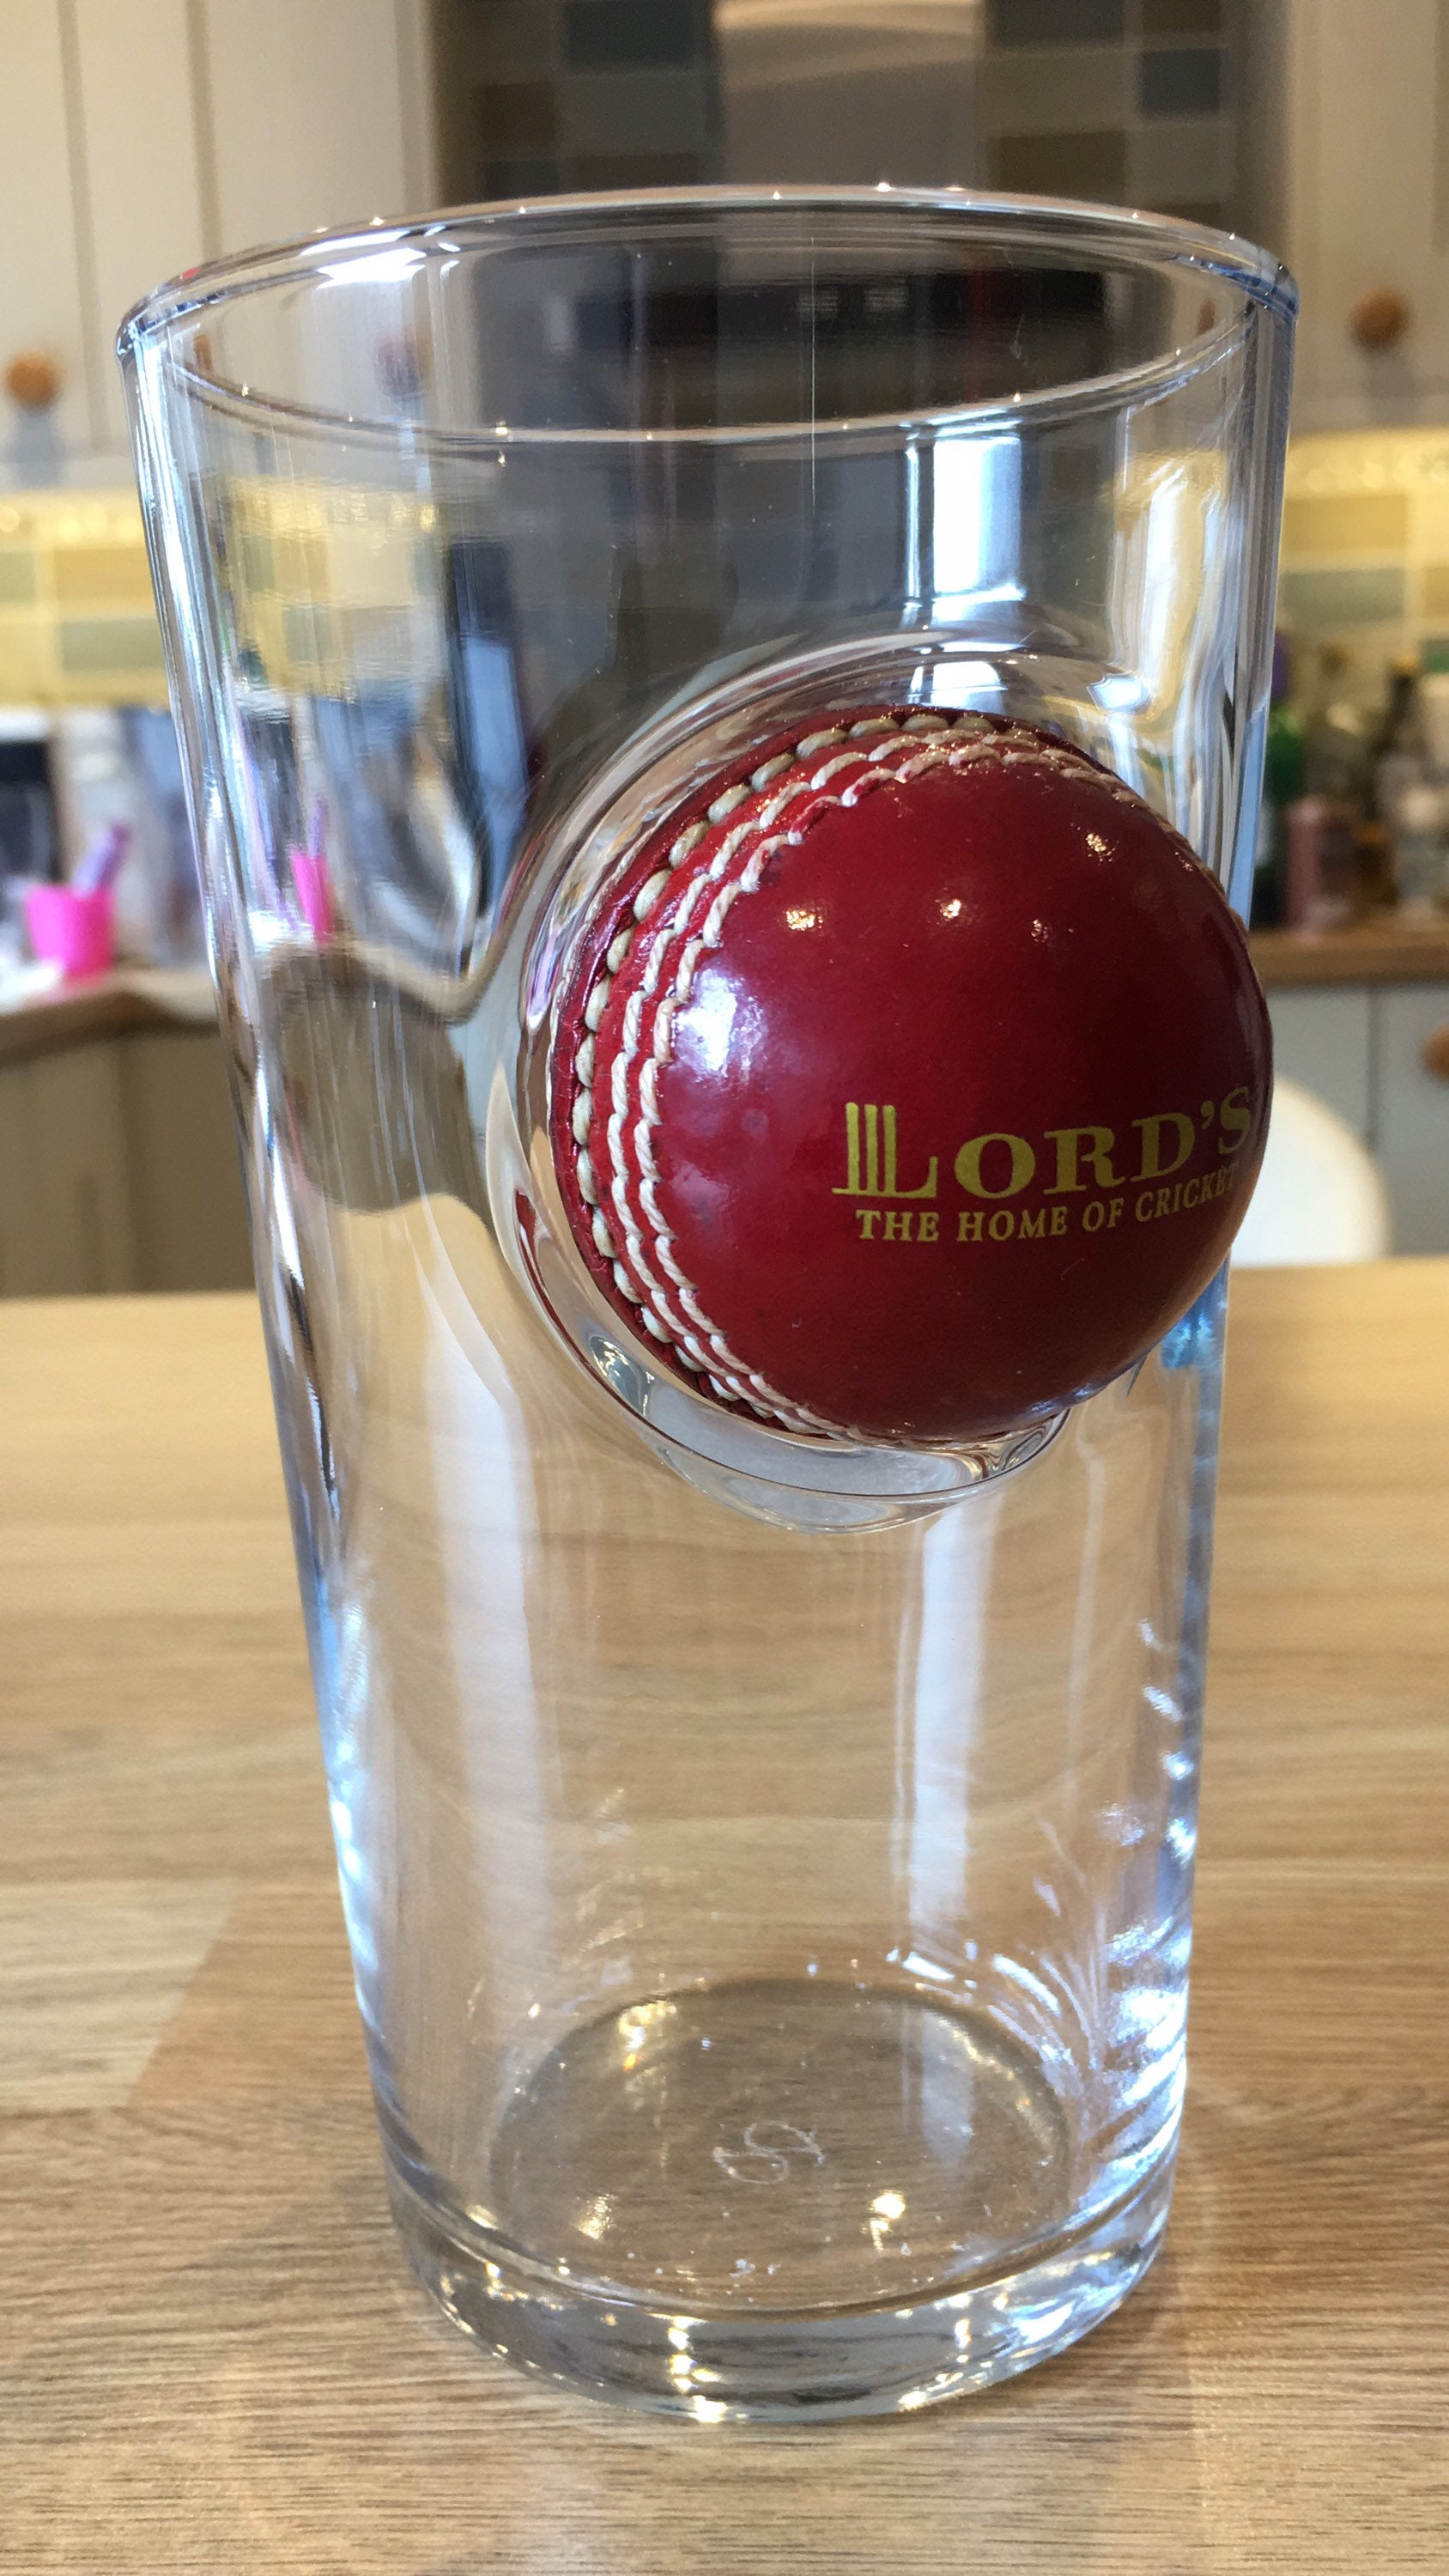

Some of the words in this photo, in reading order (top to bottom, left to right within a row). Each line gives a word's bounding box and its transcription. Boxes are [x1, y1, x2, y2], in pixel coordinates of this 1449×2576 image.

[857, 1210, 940, 1242] THE
[956, 1206, 1069, 1242] HOME
[1082, 1197, 1125, 1233] OF
